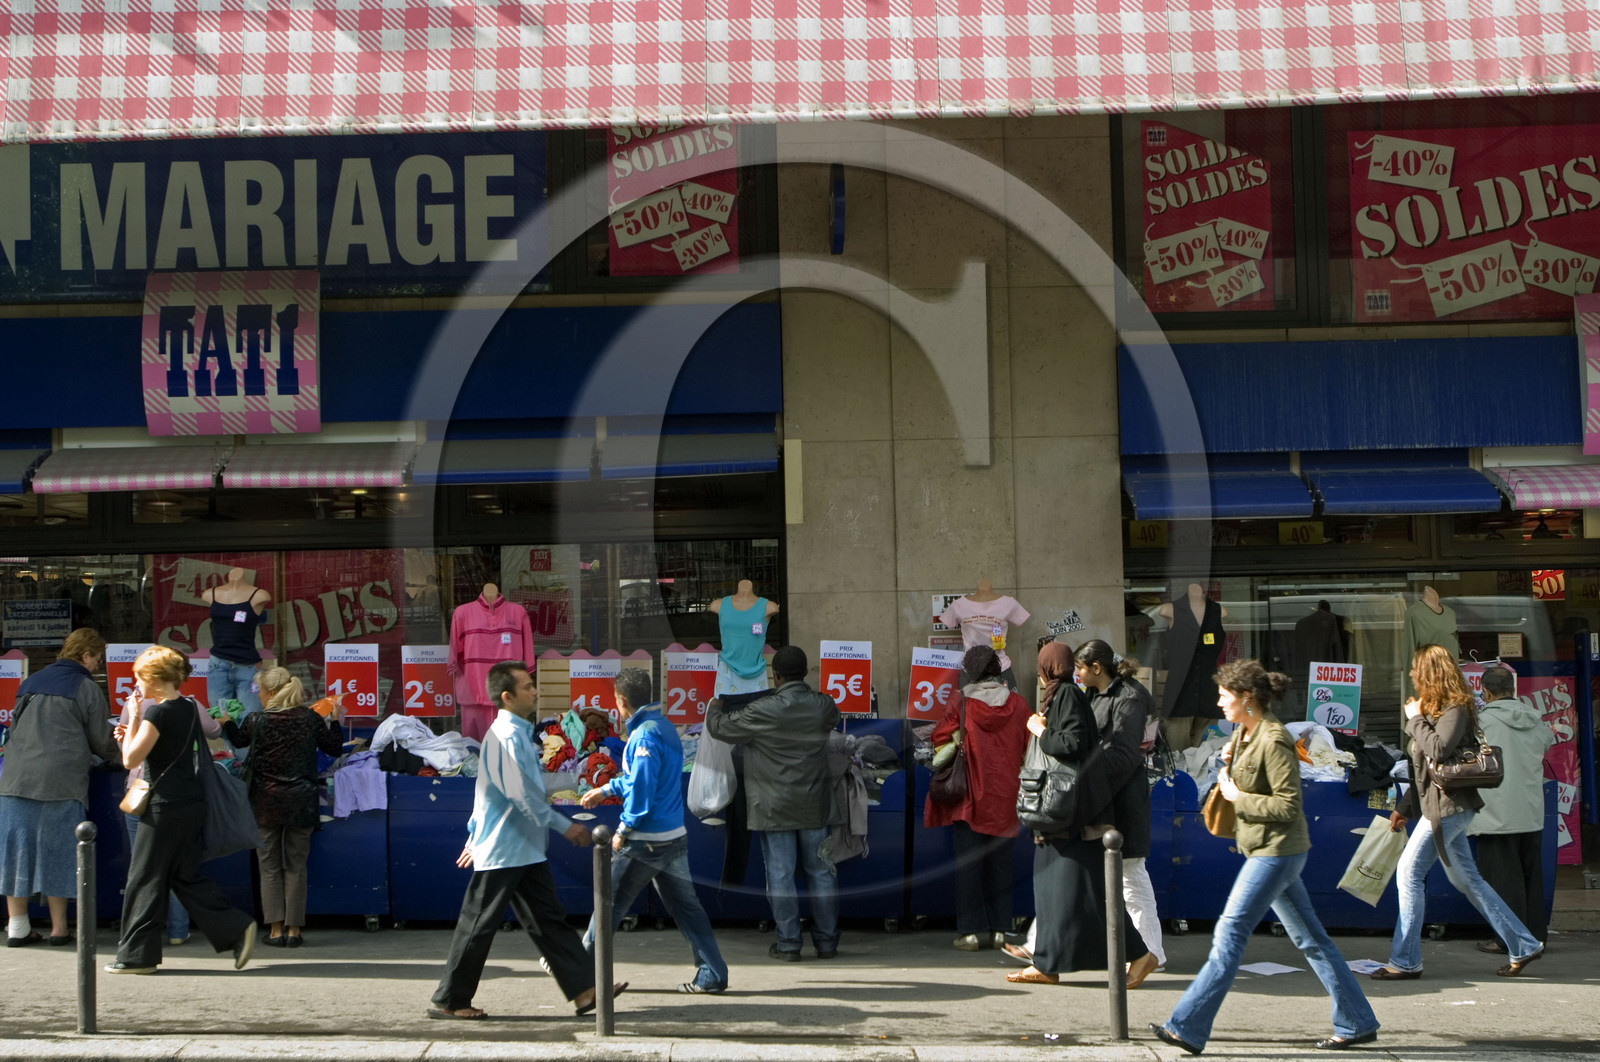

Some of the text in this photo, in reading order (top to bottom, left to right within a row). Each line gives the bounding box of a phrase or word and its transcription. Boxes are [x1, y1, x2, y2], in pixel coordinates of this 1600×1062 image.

[611, 123, 734, 179] SOLDES
[1373, 149, 1448, 177] -40%
[1146, 158, 1269, 215] SOLDES
[59, 153, 518, 272] MARIAGE
[614, 198, 685, 236] -50%
[1355, 155, 1600, 260] SOLDES
[680, 227, 723, 267] -30%
[1150, 235, 1219, 272] -50%
[1429, 253, 1518, 301] -50%
[1522, 257, 1595, 284] -30%
[158, 303, 300, 397] TATI
[915, 659, 960, 668] EXCEPTIONNEL
[1316, 665, 1357, 683] SOLDES
[826, 673, 863, 705] 5€
